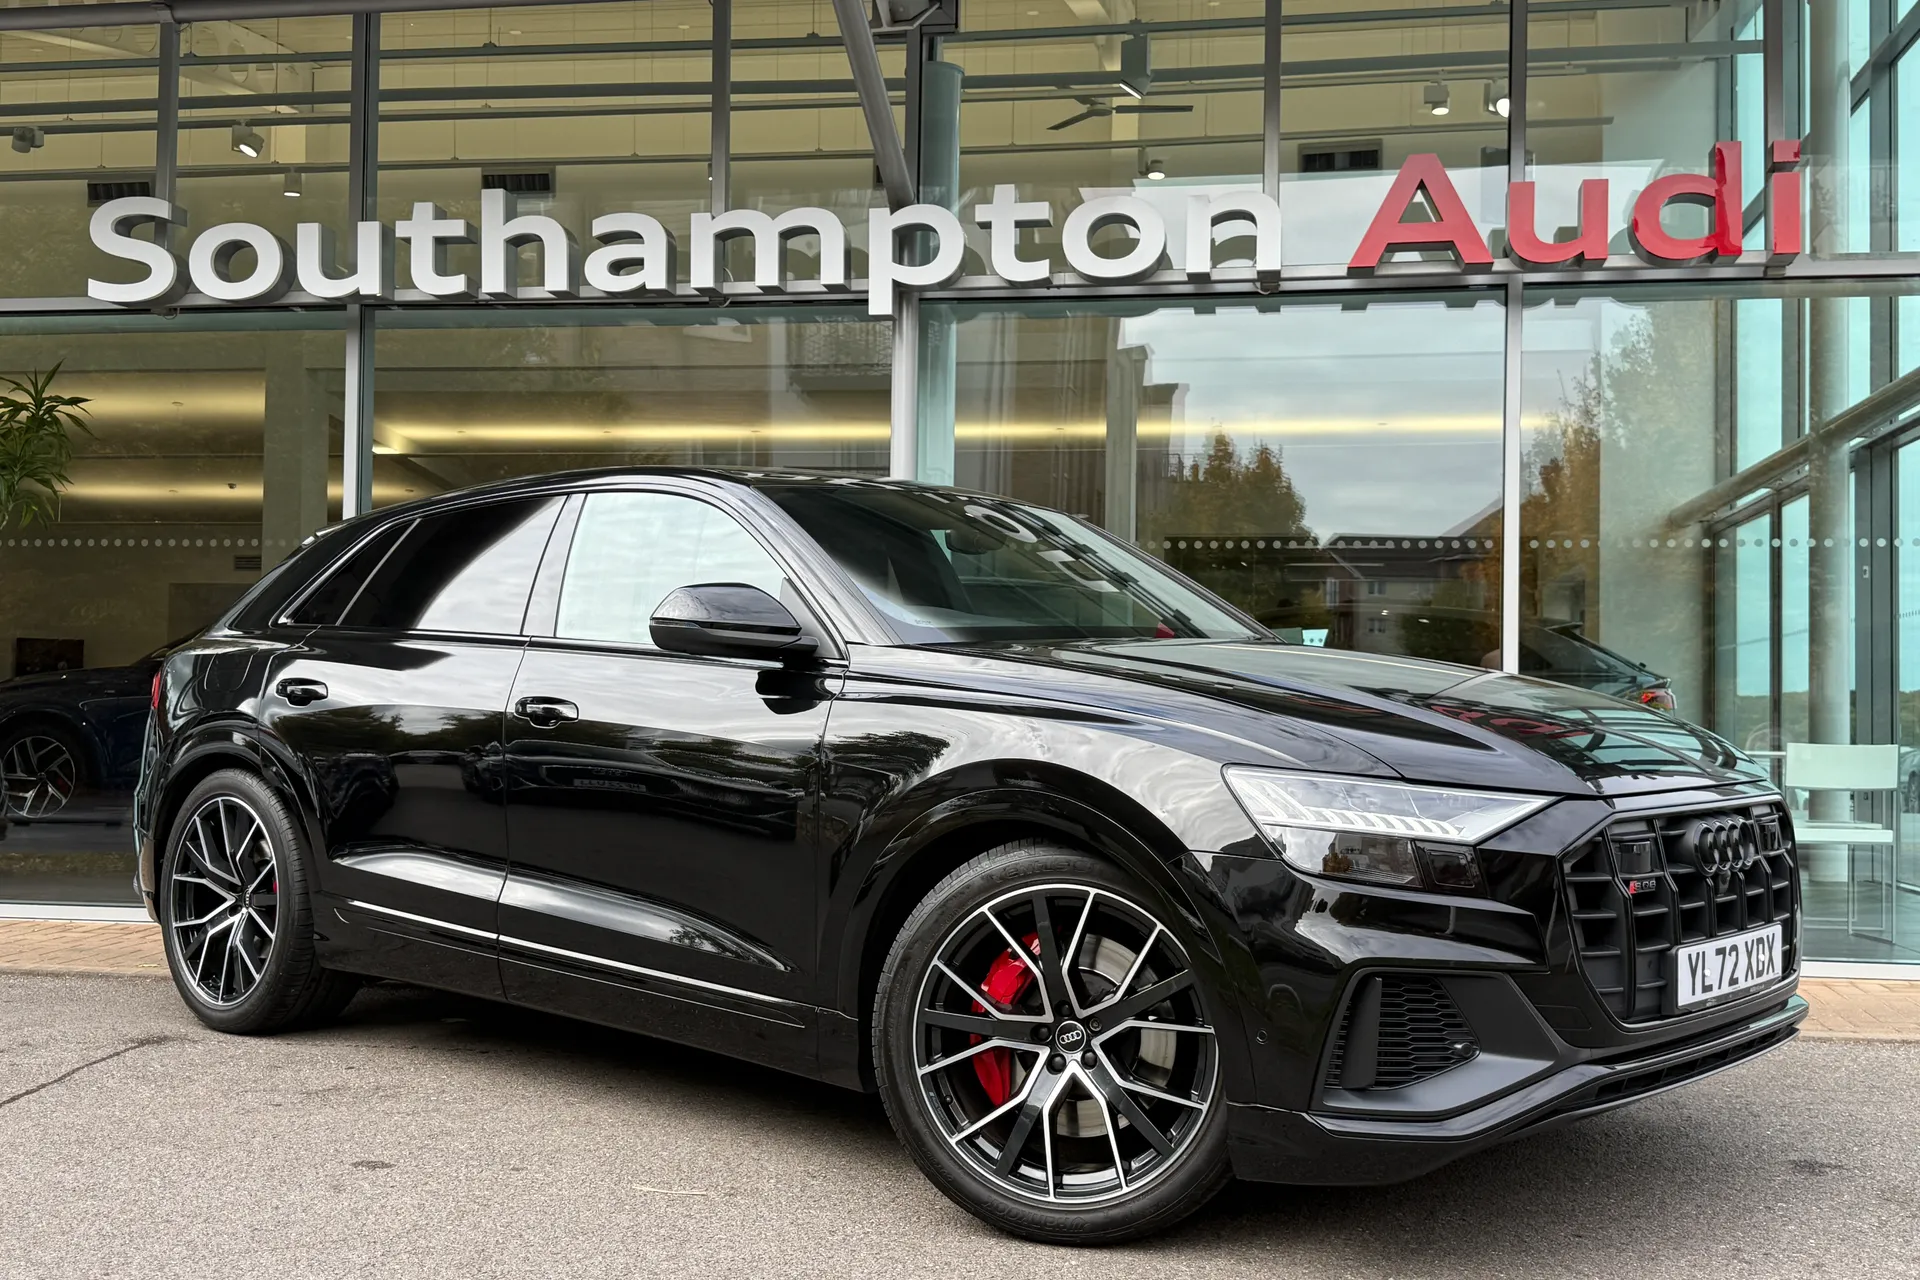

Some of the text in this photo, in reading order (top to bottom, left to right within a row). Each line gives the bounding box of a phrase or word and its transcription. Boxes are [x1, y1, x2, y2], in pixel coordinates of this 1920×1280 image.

[87, 140, 1801, 317] Southampton Audi
[1687, 932, 1775, 996] YL72 XDX
